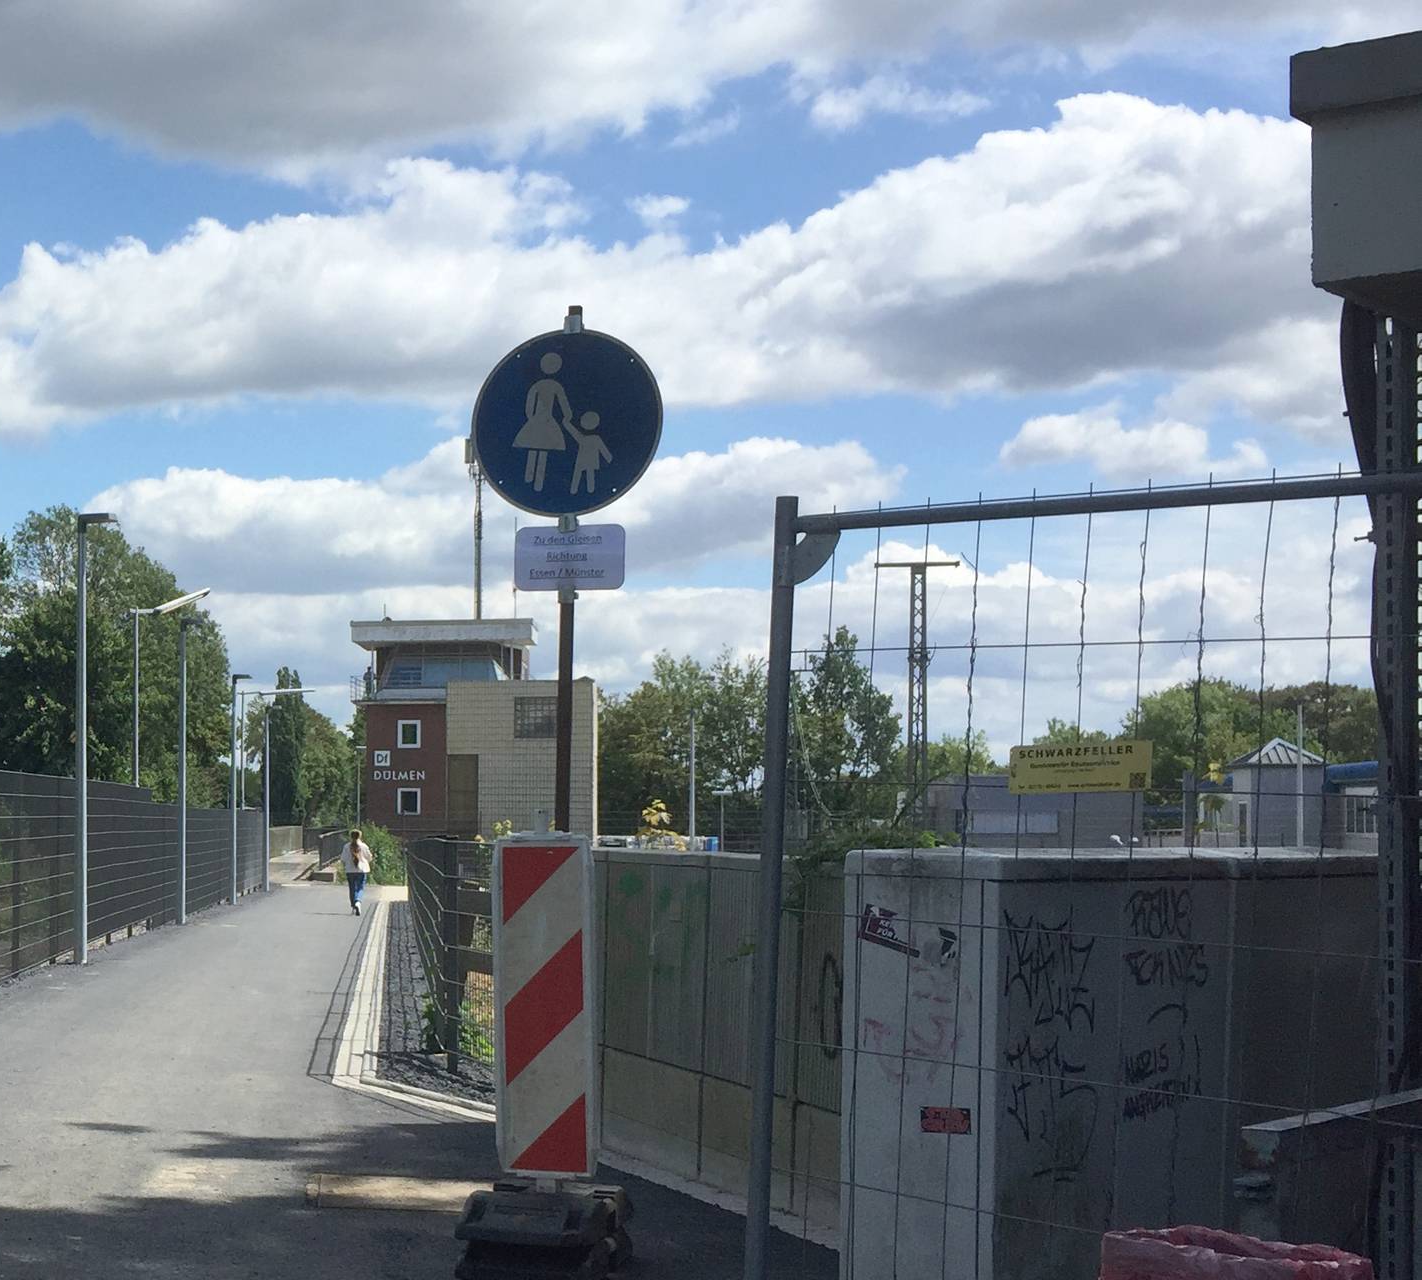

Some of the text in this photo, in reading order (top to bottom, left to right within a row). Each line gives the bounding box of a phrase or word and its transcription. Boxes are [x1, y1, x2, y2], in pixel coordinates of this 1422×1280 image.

[546, 552, 588, 561] Richtung
[530, 568, 556, 578] Essen
[1019, 744, 1134, 759] SCHWARZFELLER
